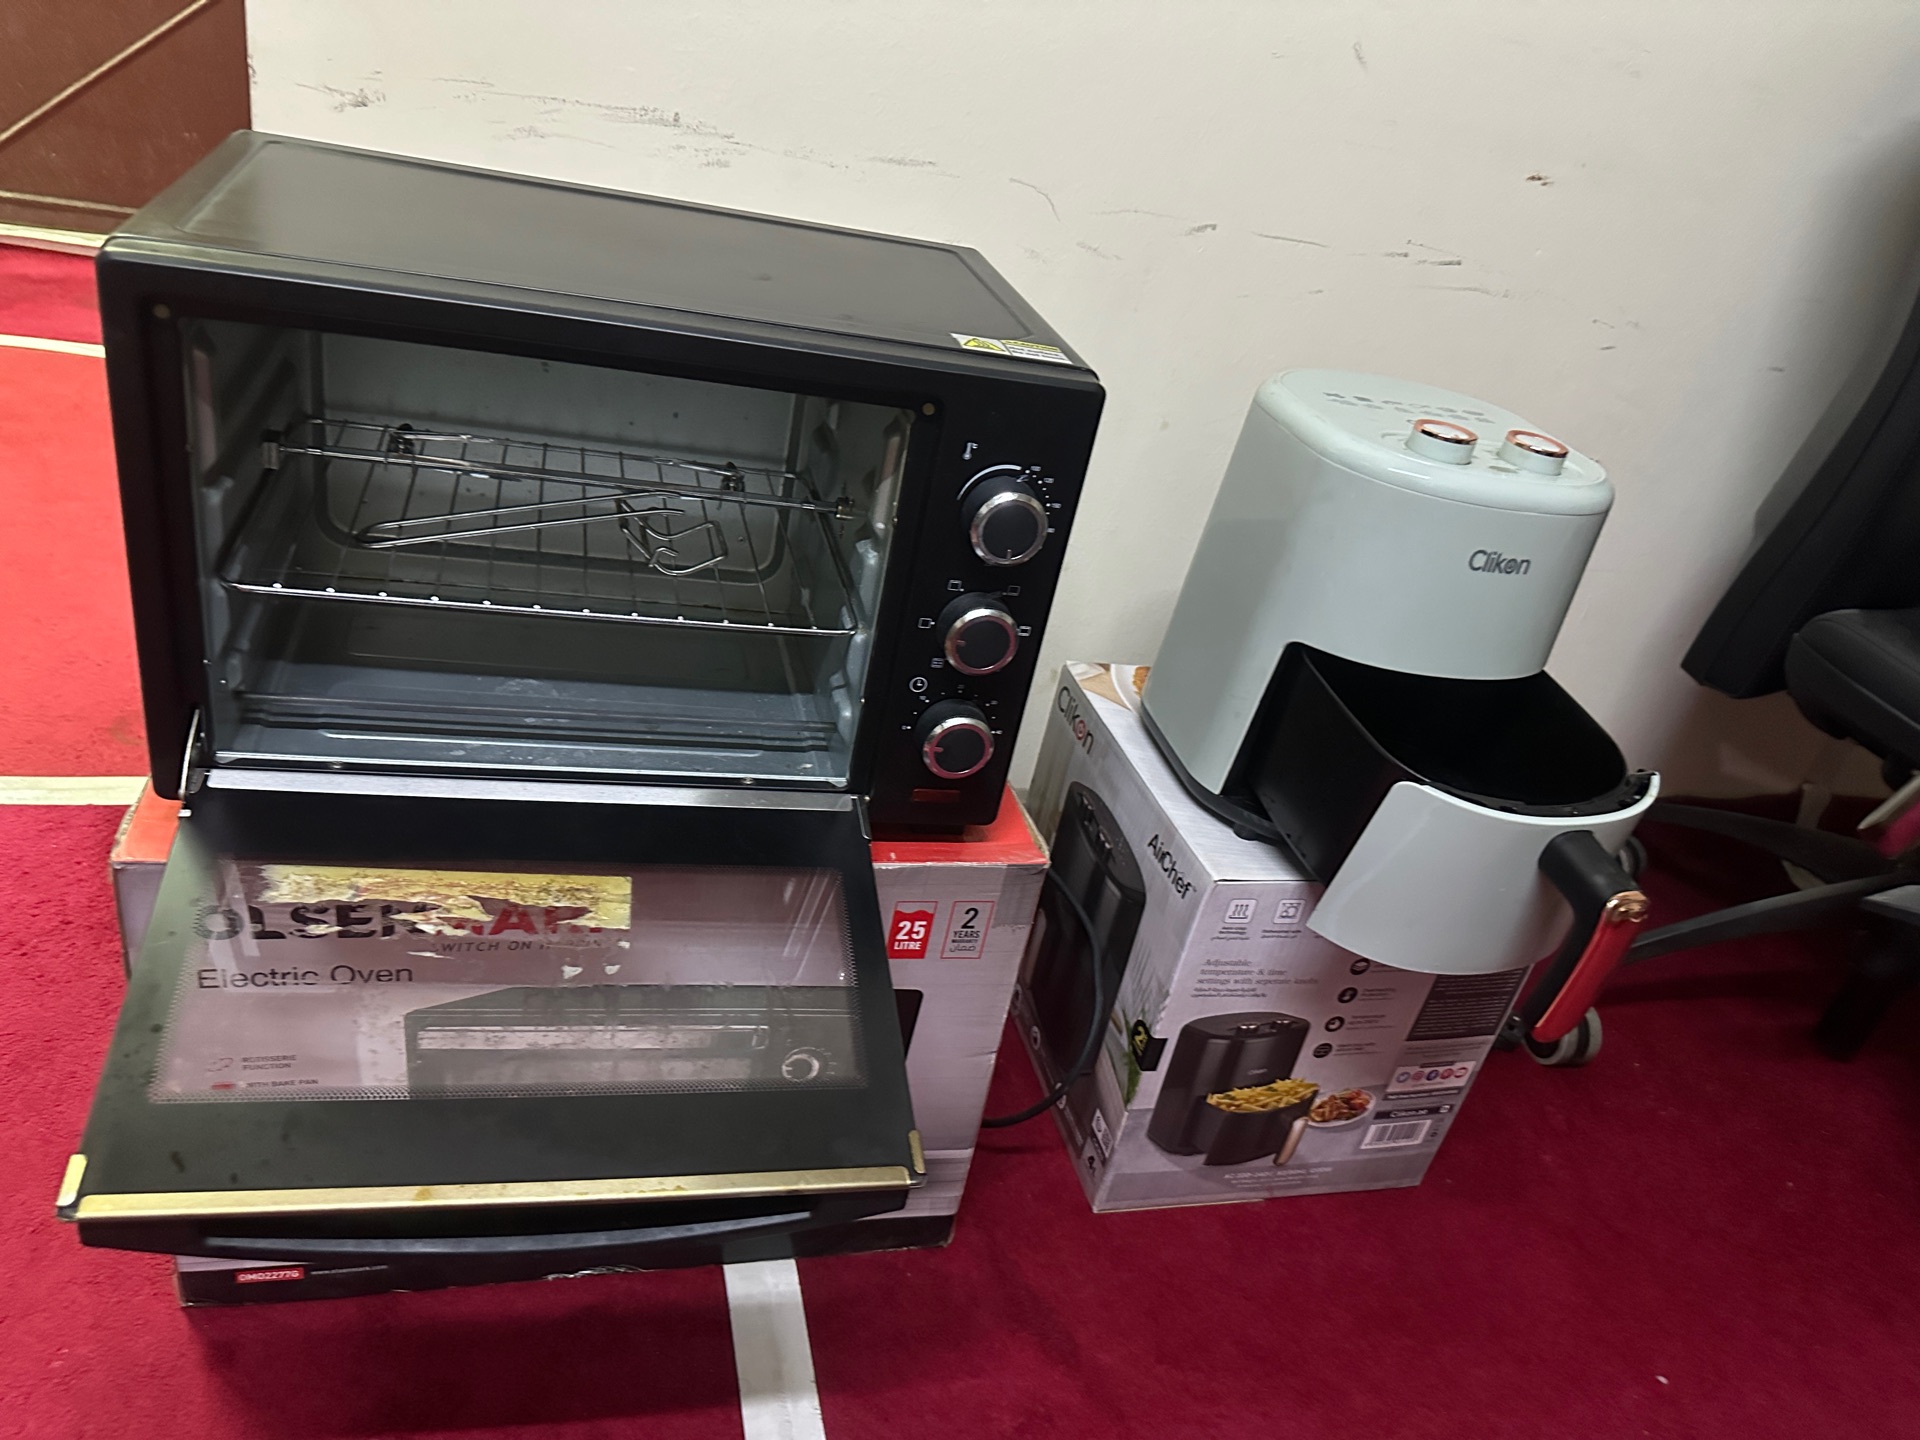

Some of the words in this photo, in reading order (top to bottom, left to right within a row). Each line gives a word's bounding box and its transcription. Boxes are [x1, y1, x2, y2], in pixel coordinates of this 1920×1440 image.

[1467, 549, 1531, 575] Clikon
[1058, 686, 1094, 755] Clikon
[1147, 833, 1193, 899] AirChef
[961, 907, 979, 929] 2
[895, 921, 927, 940] 25
[953, 930, 980, 938] YEARS
[893, 941, 922, 950] LITRE
[197, 966, 320, 989] Electric
[330, 964, 413, 984] Oven
[241, 1062, 291, 1071] FUNCTION
